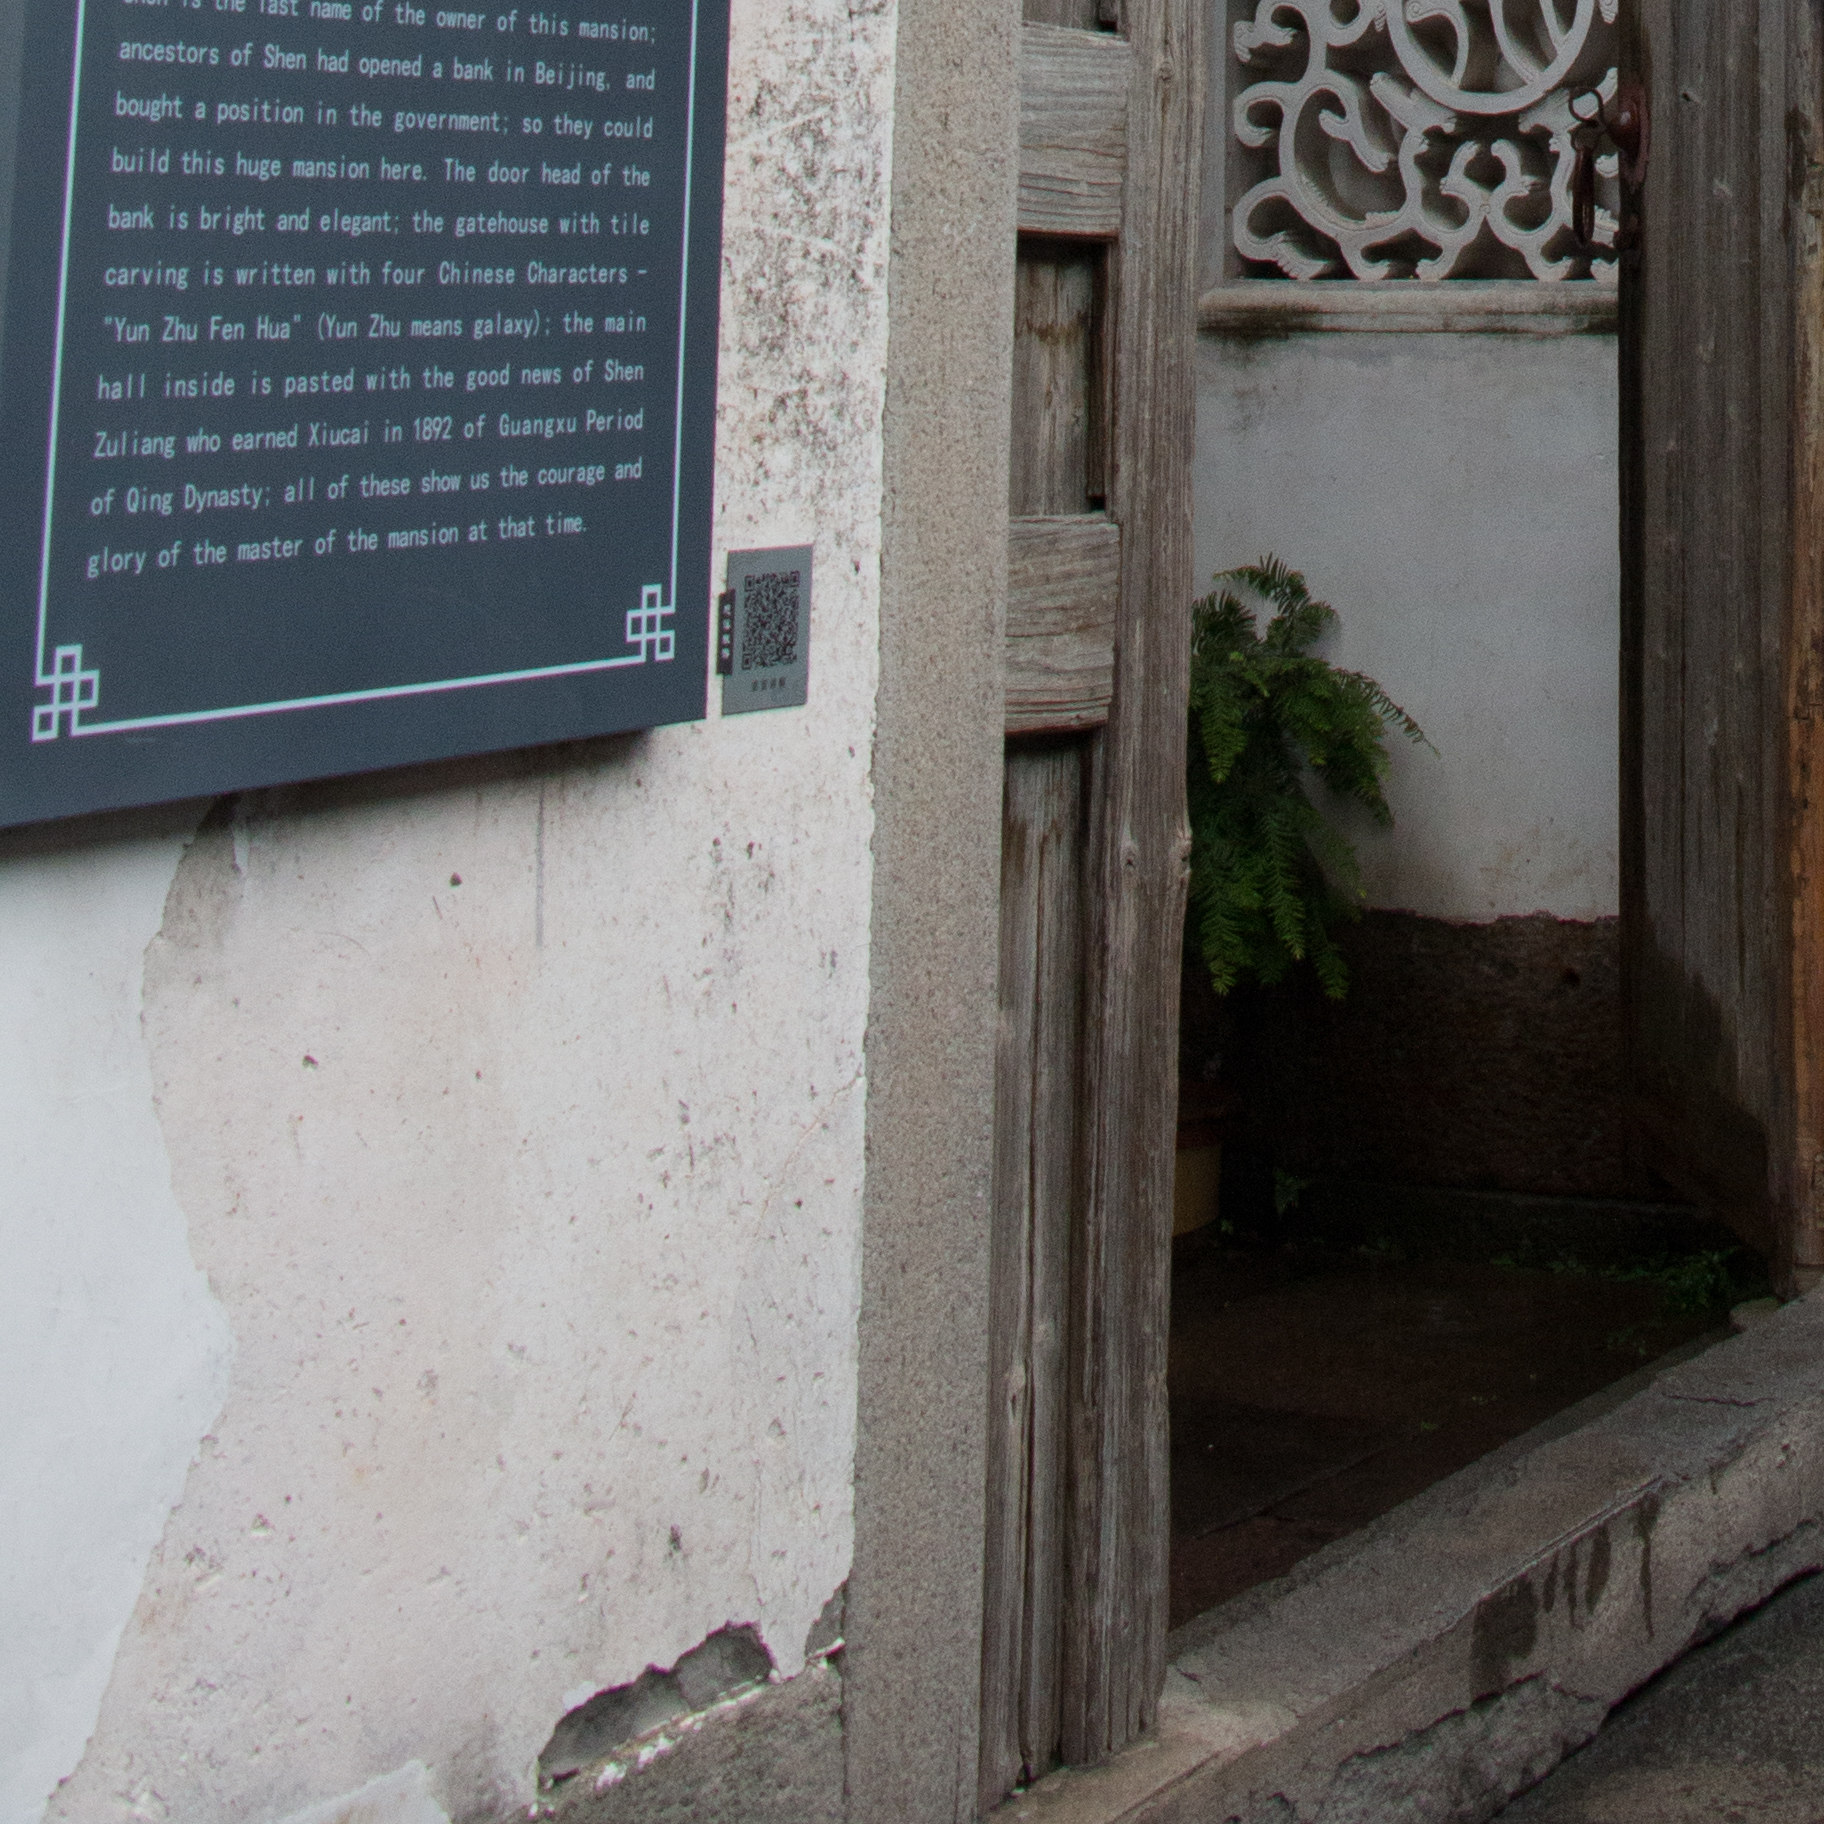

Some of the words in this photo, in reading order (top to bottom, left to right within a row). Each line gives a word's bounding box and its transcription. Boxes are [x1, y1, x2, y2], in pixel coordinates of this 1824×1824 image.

[310, 0, 353, 21] name
[394, 1, 426, 26] the
[435, 10, 486, 30] owner
[528, 11, 569, 37] this
[578, 18, 656, 44] mansion;
[119, 40, 220, 66] ancestors
[263, 42, 308, 70] Shen
[317, 47, 350, 74] had
[358, 53, 423, 79] opened
[453, 56, 494, 81] bank
[506, 59, 525, 83] in
[534, 60, 611, 92] Beijing,
[625, 68, 656, 91] and
[115, 90, 183, 123] bought
[216, 97, 305, 125] position
[317, 101, 338, 125] in
[349, 102, 383, 128] the
[393, 110, 508, 134] government;
[522, 116, 544, 134] so
[553, 112, 594, 140] they
[603, 115, 654, 139] could
[111, 146, 171, 174] build
[181, 149, 226, 176] this
[235, 151, 282, 182] huge
[292, 155, 370, 180] mansion
[380, 156, 427, 181] here.
[444, 156, 477, 183] The
[487, 159, 530, 184] door
[541, 161, 582, 185] head
[622, 164, 651, 187] the
[108, 203, 155, 229] bank
[199, 204, 266, 236] bright
[276, 206, 311, 232] and
[319, 207, 399, 237] elegant;
[412, 209, 445, 233] the
[455, 210, 549, 238] gatehouse
[559, 211, 601, 235] with
[610, 212, 650, 235] tile
[104, 260, 190, 291] carving
[235, 260, 316, 286] written
[326, 261, 371, 285] with
[381, 260, 426, 285] four
[438, 260, 516, 285] Chinese
[526, 259, 628, 285] Characters
[104, 315, 151, 342] "Yun
[162, 314, 199, 342] Zhu
[209, 314, 246, 341] Fen
[256, 313, 302, 340] Hua"
[317, 312, 358, 341] (Yun
[368, 312, 402, 338] Zhu
[410, 319, 463, 337] means
[473, 308, 550, 341] galaxy);
[562, 310, 595, 334] the
[604, 310, 647, 333] main
[97, 373, 146, 400] hall
[165, 371, 236, 398] inside
[284, 367, 355, 398] pasted
[366, 365, 411, 391] with
[422, 365, 455, 389] the
[466, 362, 511, 392] good
[521, 366, 562, 385] news
[603, 358, 645, 383] Shen
[94, 430, 177, 460] Zuliang
[186, 427, 222, 453] who
[231, 423, 299, 451] earned
[308, 420, 369, 447] Xiucai
[384, 419, 403, 443] in
[413, 414, 453, 442] 1892
[498, 412, 578, 439] Guangxu
[585, 407, 645, 432] Period
[125, 485, 174, 516] Qing
[183, 482, 270, 514] Dynasty;
[284, 476, 315, 503] all
[360, 472, 411, 498] these
[421, 469, 462, 494] show
[470, 472, 490, 491] us
[499, 464, 529, 488] the
[537, 464, 606, 487] courage
[614, 455, 643, 481] and
[86, 546, 147, 579] glory
[193, 538, 228, 565] the
[237, 536, 304, 561] master
[347, 527, 379, 553] the
[387, 521, 459, 548] mansion
[468, 519, 488, 542] at
[498, 515, 536, 540] that
[545, 511, 587, 536] time.
